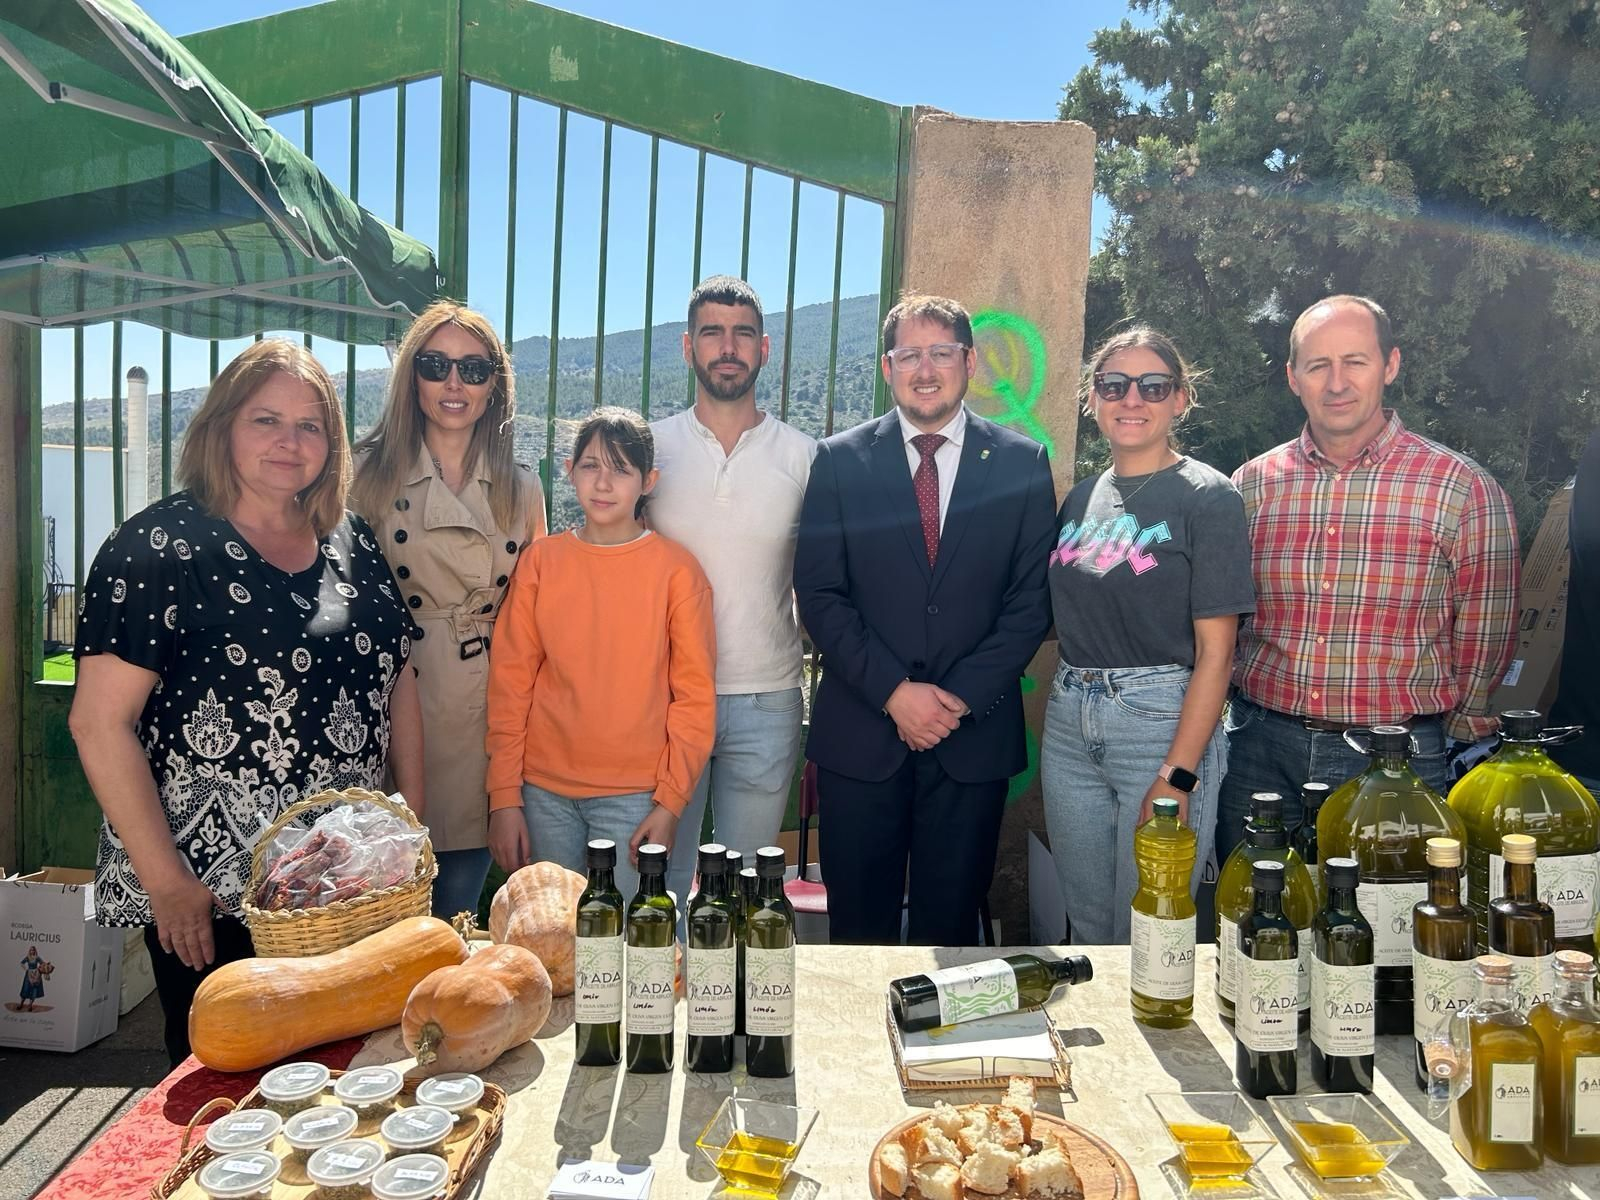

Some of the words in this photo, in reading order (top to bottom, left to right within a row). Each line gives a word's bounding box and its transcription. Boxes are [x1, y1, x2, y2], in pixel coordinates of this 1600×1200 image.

[1556, 889, 1584, 901] ADA
[10, 931, 61, 943] LAURICIUS
[591, 971, 621, 984] ADA
[640, 982, 672, 994] ADA
[702, 984, 732, 996] ADA
[761, 984, 792, 996] ADA
[1269, 996, 1298, 1009] ADA
[1343, 1002, 1374, 1014] ADA
[1508, 1086, 1530, 1094] ADA
[592, 1175, 625, 1185] ADA
